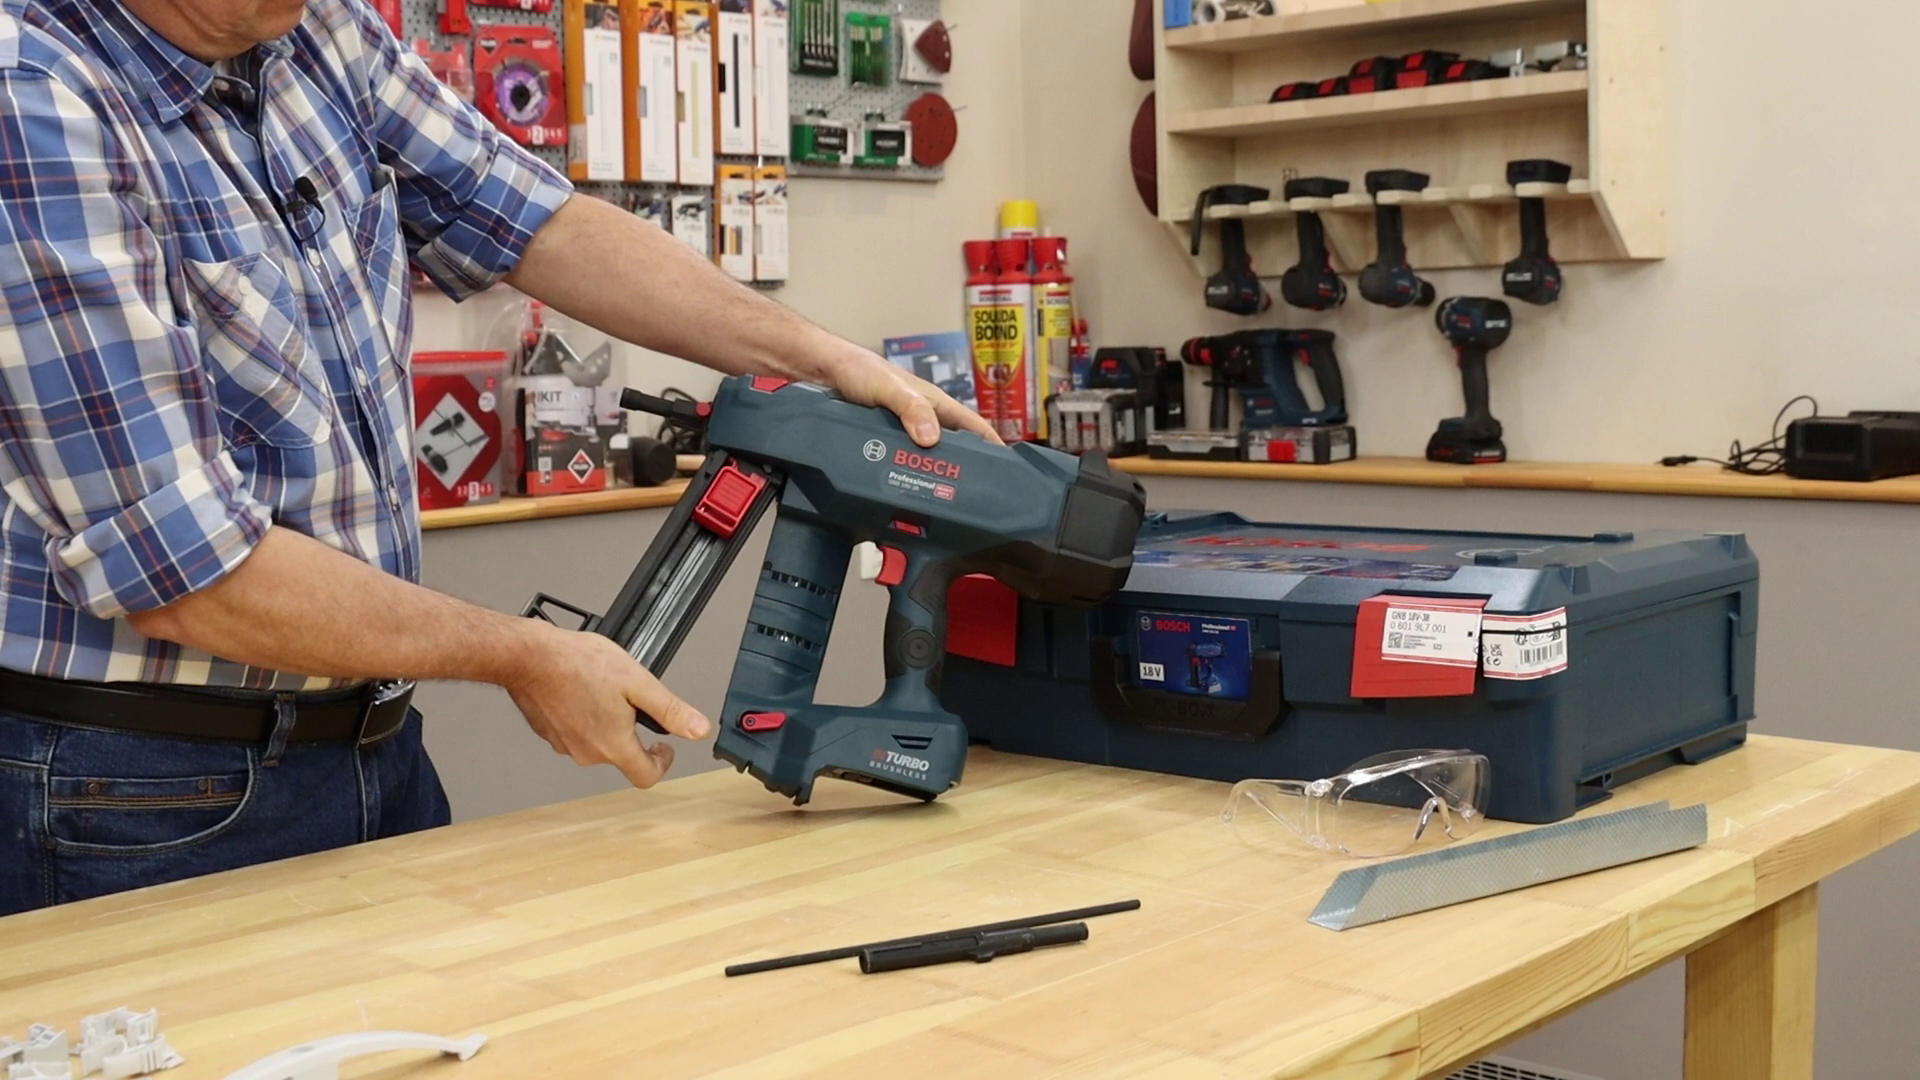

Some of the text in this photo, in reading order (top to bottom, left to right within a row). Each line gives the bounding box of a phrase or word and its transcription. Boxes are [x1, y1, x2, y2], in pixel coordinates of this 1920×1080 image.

[894, 449, 961, 479] BOSCH
[888, 471, 936, 490] Professional
[1391, 611, 1407, 621] GNB
[1155, 619, 1191, 633] BOSCH
[868, 760, 927, 781] BRUSHLESS
